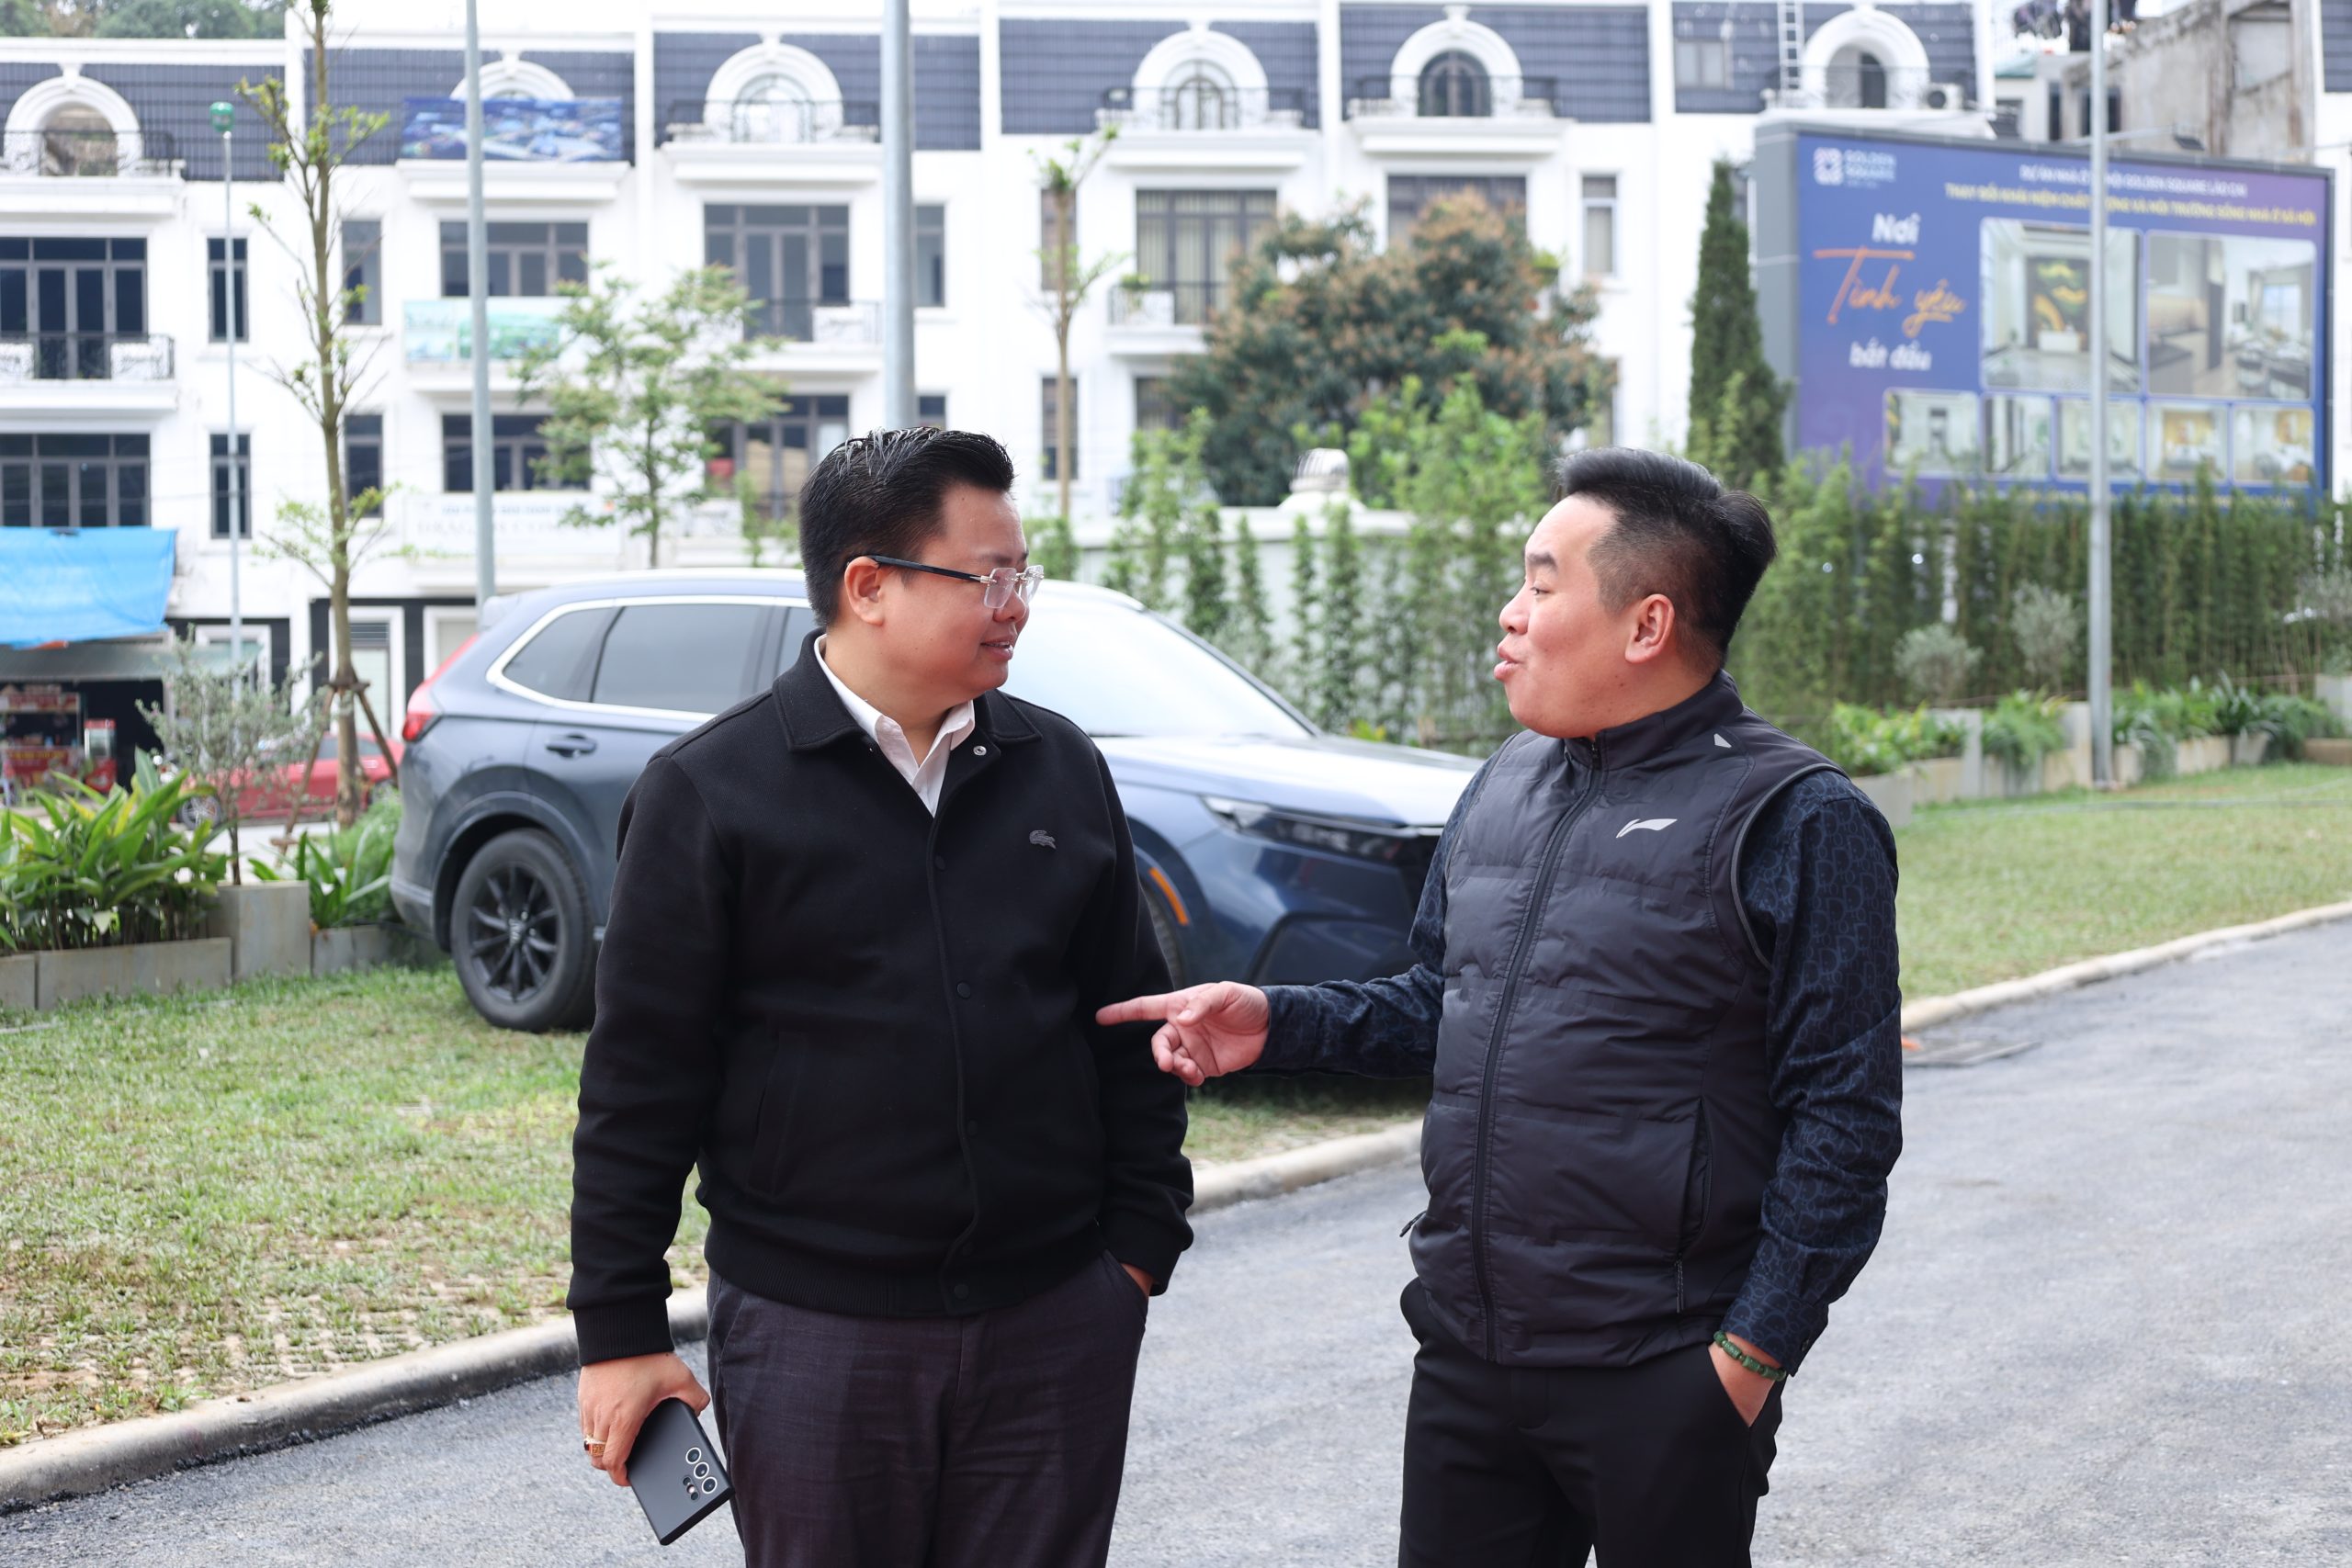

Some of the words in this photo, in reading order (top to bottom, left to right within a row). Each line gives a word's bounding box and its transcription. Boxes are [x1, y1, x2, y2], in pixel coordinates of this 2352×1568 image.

[1944, 182, 1974, 199] THAY
[1871, 212, 1921, 245] Nơi
[1902, 278, 1966, 339] yêu
[1849, 336, 1889, 368] bắt
[1889, 339, 1933, 371] đầu
